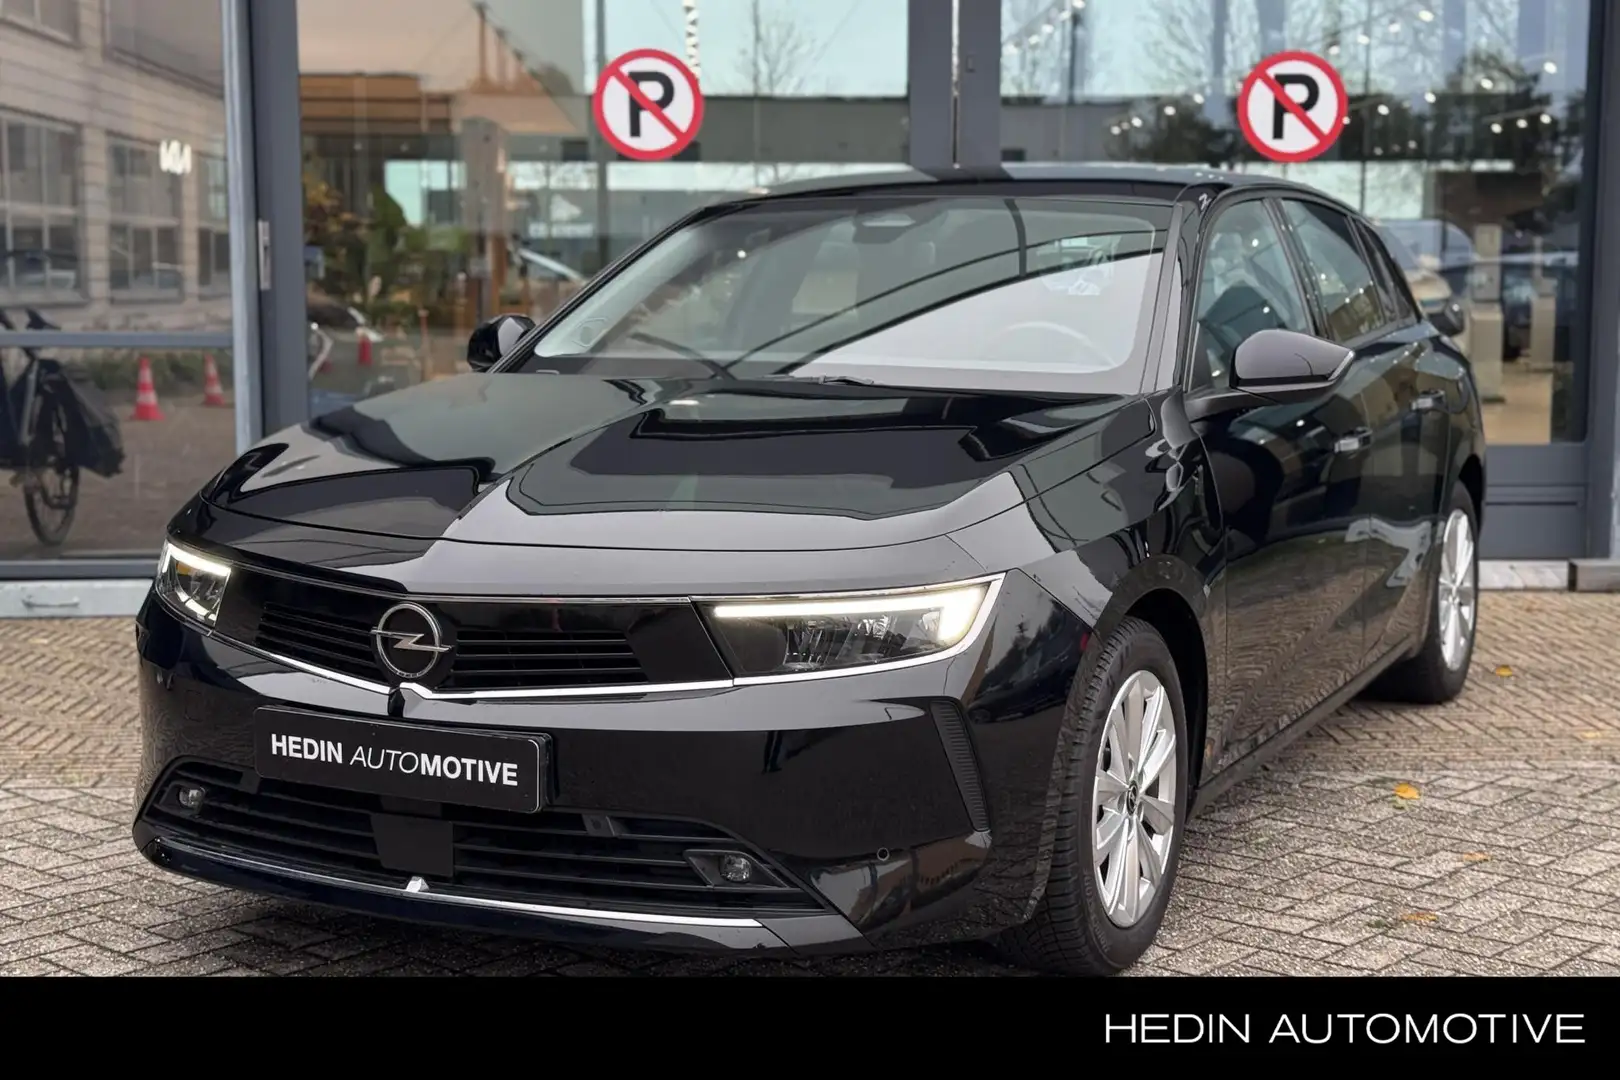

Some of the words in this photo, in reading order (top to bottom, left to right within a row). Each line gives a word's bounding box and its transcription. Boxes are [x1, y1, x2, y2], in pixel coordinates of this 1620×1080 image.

[628, 71, 674, 137] P
[1272, 74, 1319, 139] P
[271, 733, 343, 763] HEDIN
[350, 745, 518, 786] AUTOMOTIVE
